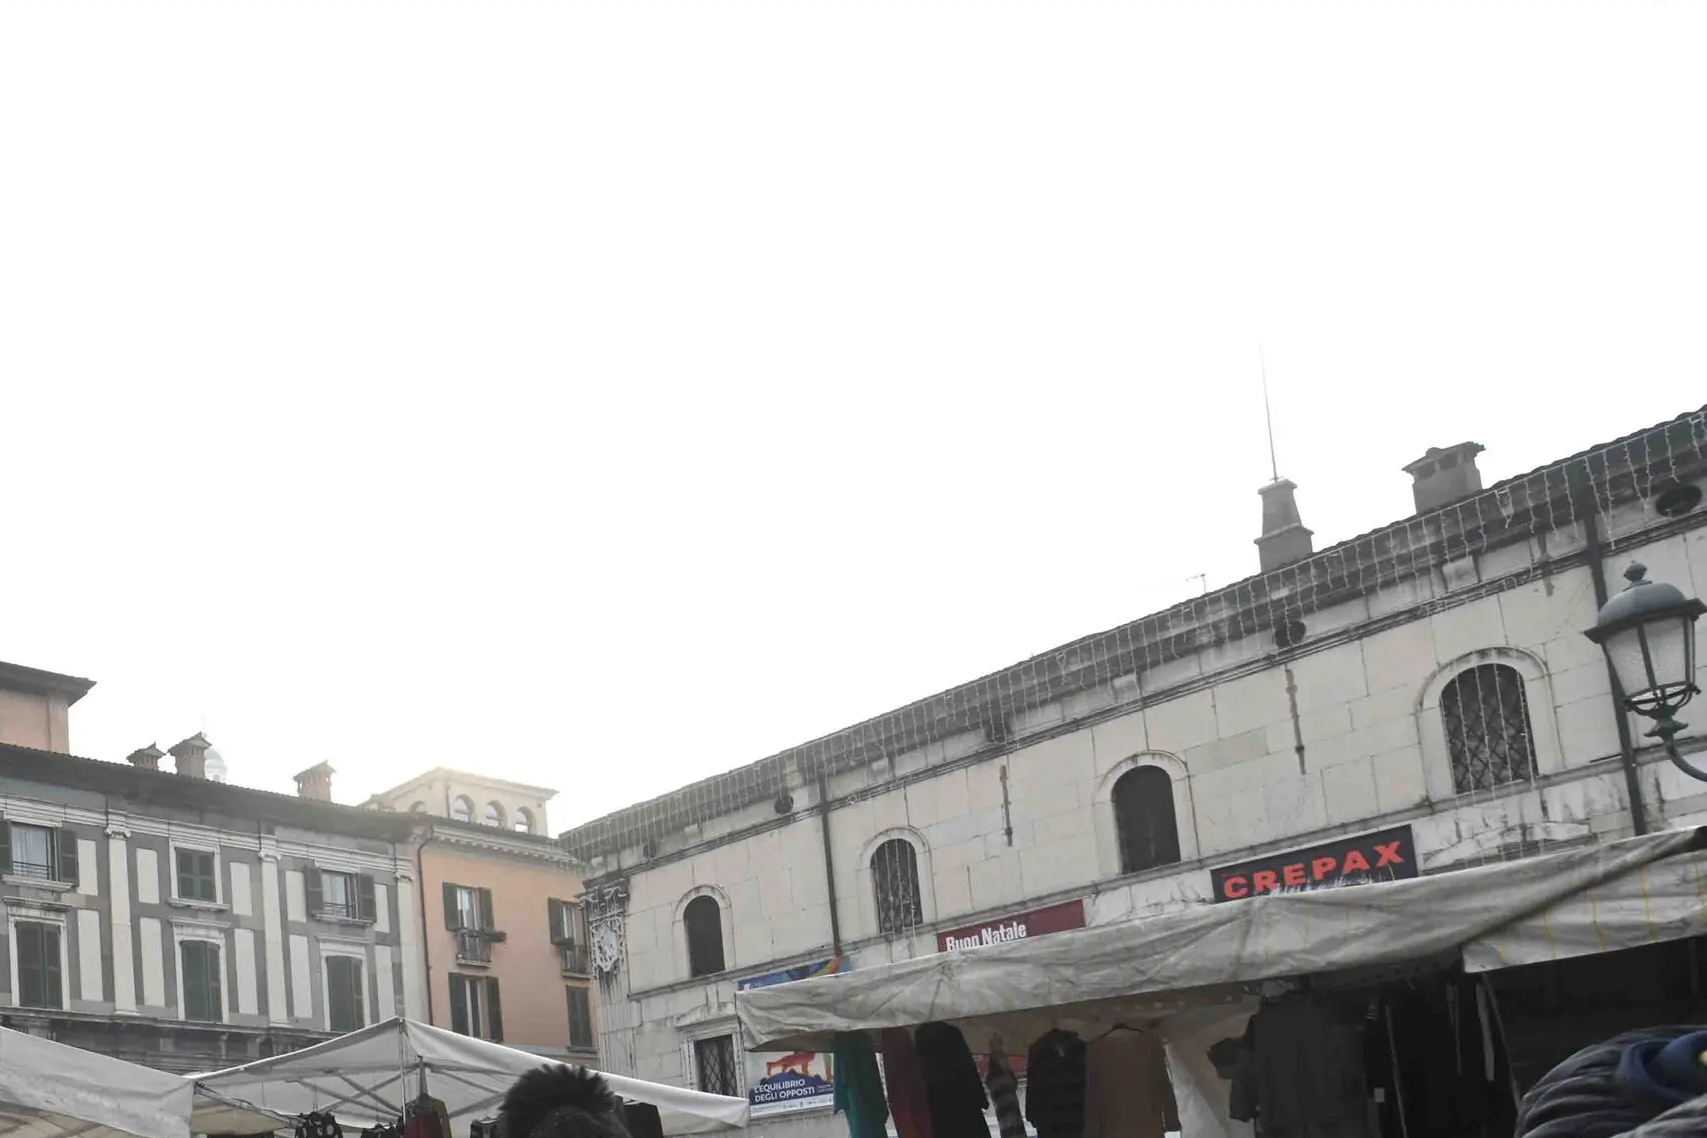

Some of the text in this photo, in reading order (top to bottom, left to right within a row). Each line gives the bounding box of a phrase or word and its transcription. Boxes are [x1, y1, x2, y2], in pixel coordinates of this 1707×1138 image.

[1223, 840, 1405, 898] CREPAX
[945, 921, 1027, 951] Buon Natale
[754, 1078, 806, 1094] L'EQUILIBRIO
[755, 1089, 778, 1103] DEGLI
[779, 1086, 815, 1099] OPPOSTI
